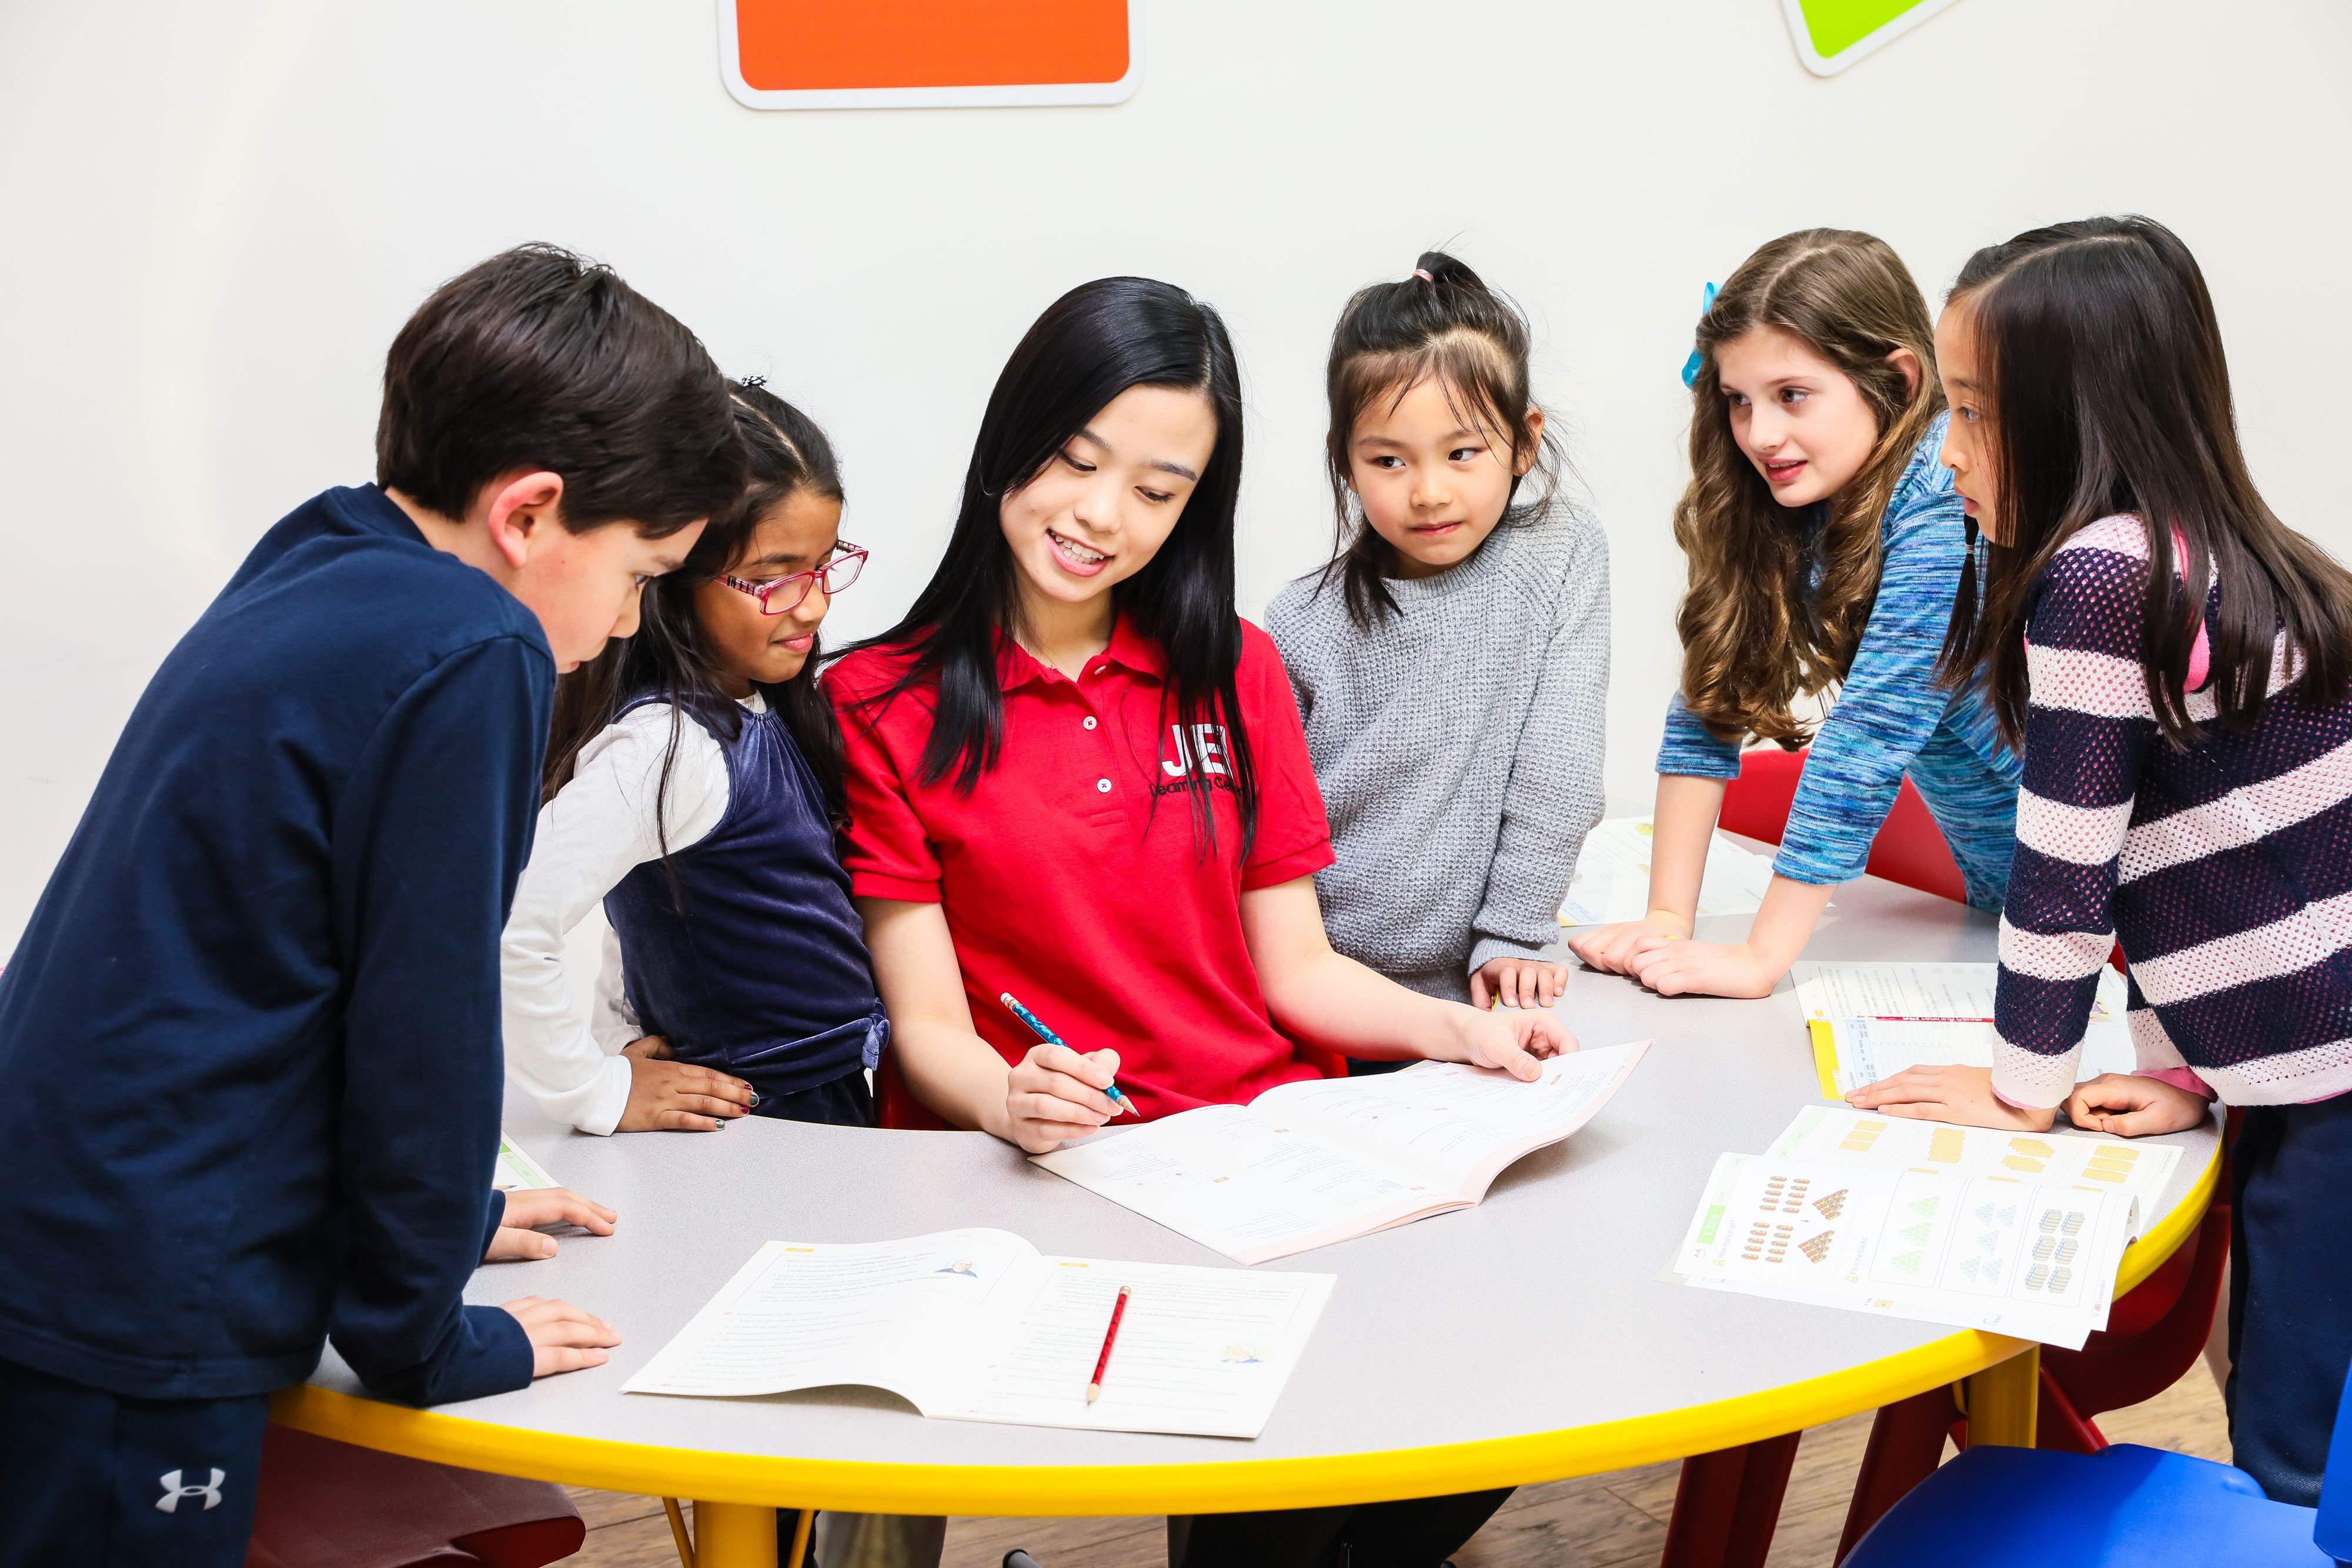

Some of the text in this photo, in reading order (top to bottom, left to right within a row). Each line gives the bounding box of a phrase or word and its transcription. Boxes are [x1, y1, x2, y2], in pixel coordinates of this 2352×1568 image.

[1149, 778, 1212, 797] Learnng
[1706, 1214, 1719, 1229] 331b
[1722, 1234, 1734, 1247] many
[1718, 1248, 1727, 1258] How
